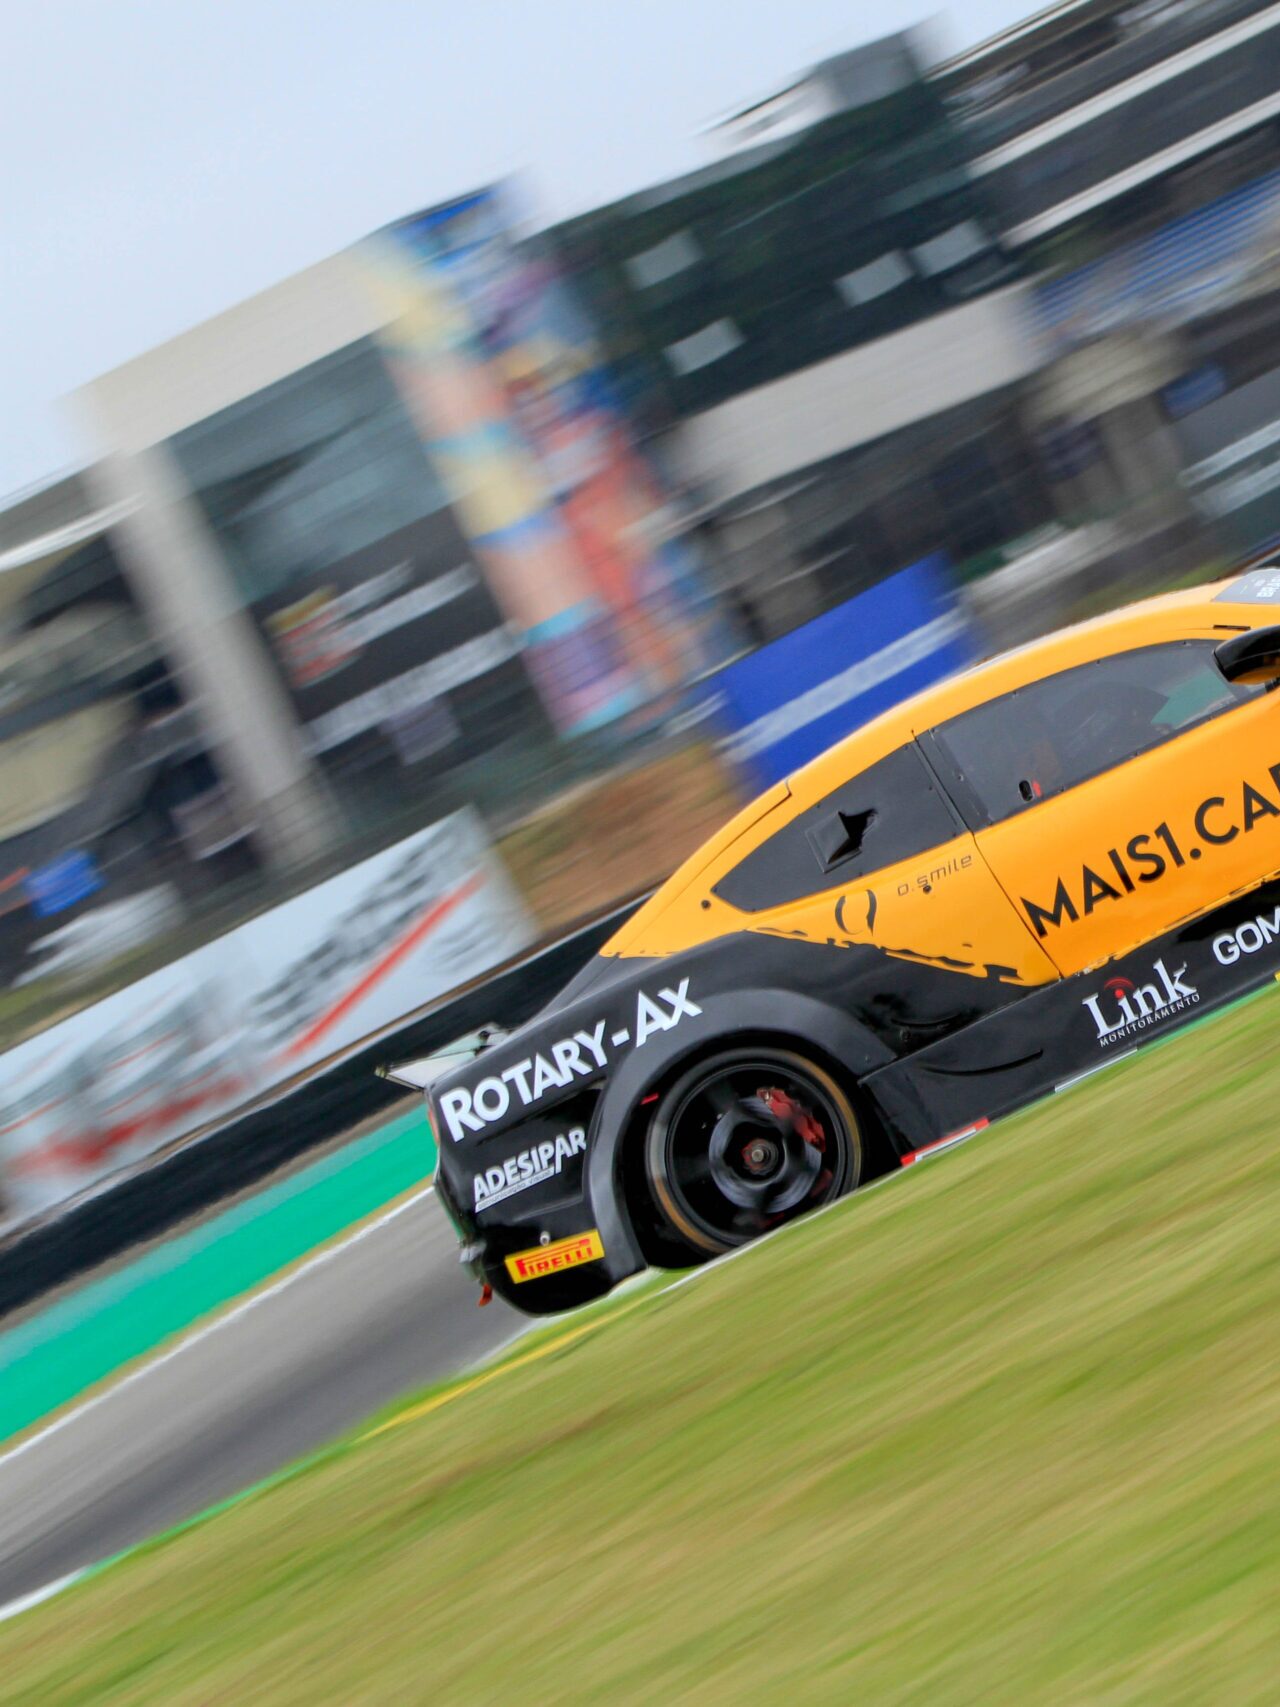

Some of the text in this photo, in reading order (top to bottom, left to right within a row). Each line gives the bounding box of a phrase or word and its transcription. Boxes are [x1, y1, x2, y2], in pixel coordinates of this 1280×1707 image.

[1082, 957, 1198, 1039] Link
[1100, 994, 1200, 1048] MONITORAMENTO
[440, 977, 703, 1143] ROTARY-AX
[474, 1125, 587, 1203] ADESIPAR
[515, 1238, 593, 1279] PIRELLI
